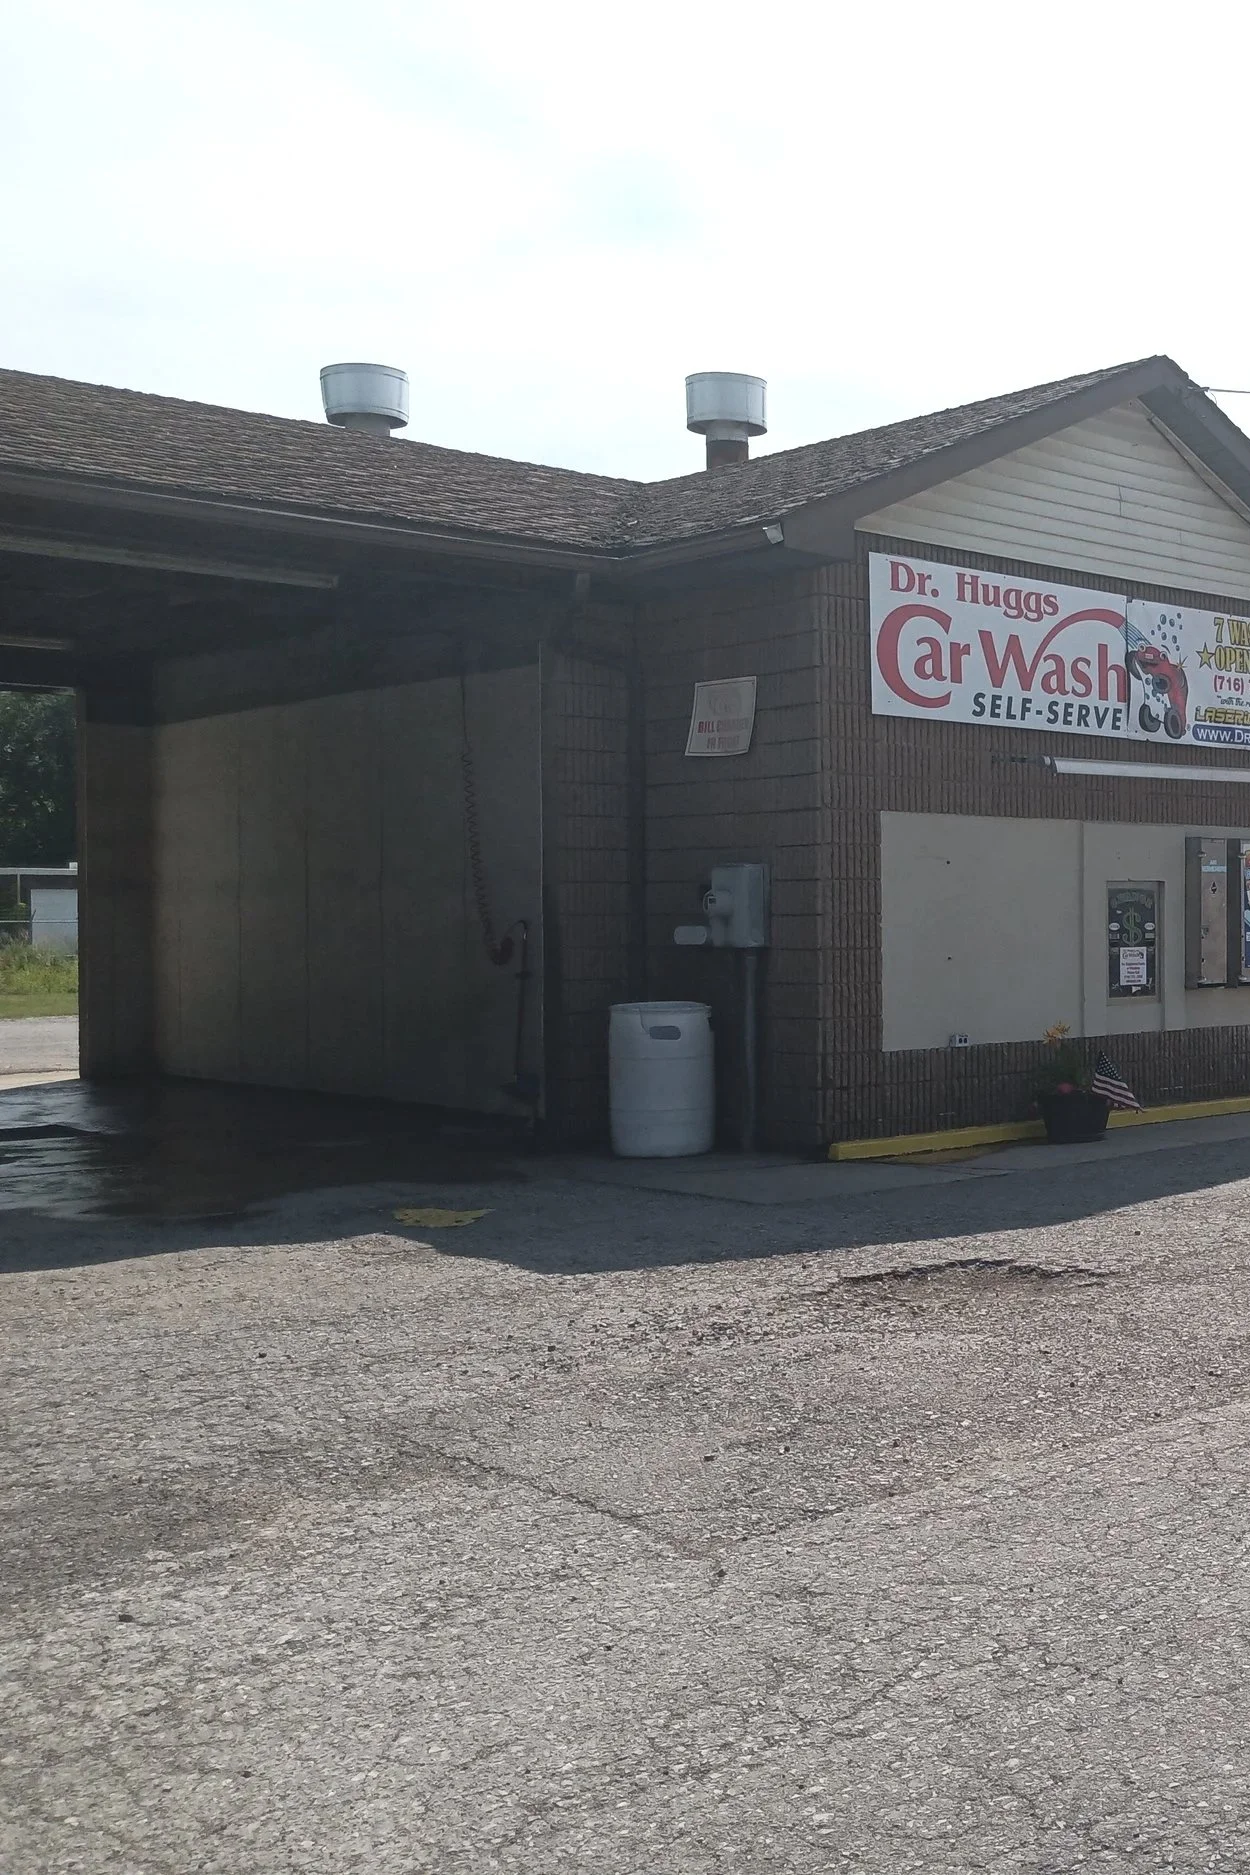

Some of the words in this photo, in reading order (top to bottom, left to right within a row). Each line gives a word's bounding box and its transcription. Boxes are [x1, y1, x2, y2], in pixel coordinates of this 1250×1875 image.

[889, 561, 939, 597] Dr.
[956, 572, 1059, 622] Huggs
[1214, 617, 1224, 643] 7
[1214, 675, 1244, 695] (716)
[972, 692, 1122, 731] SELF-SERVE
